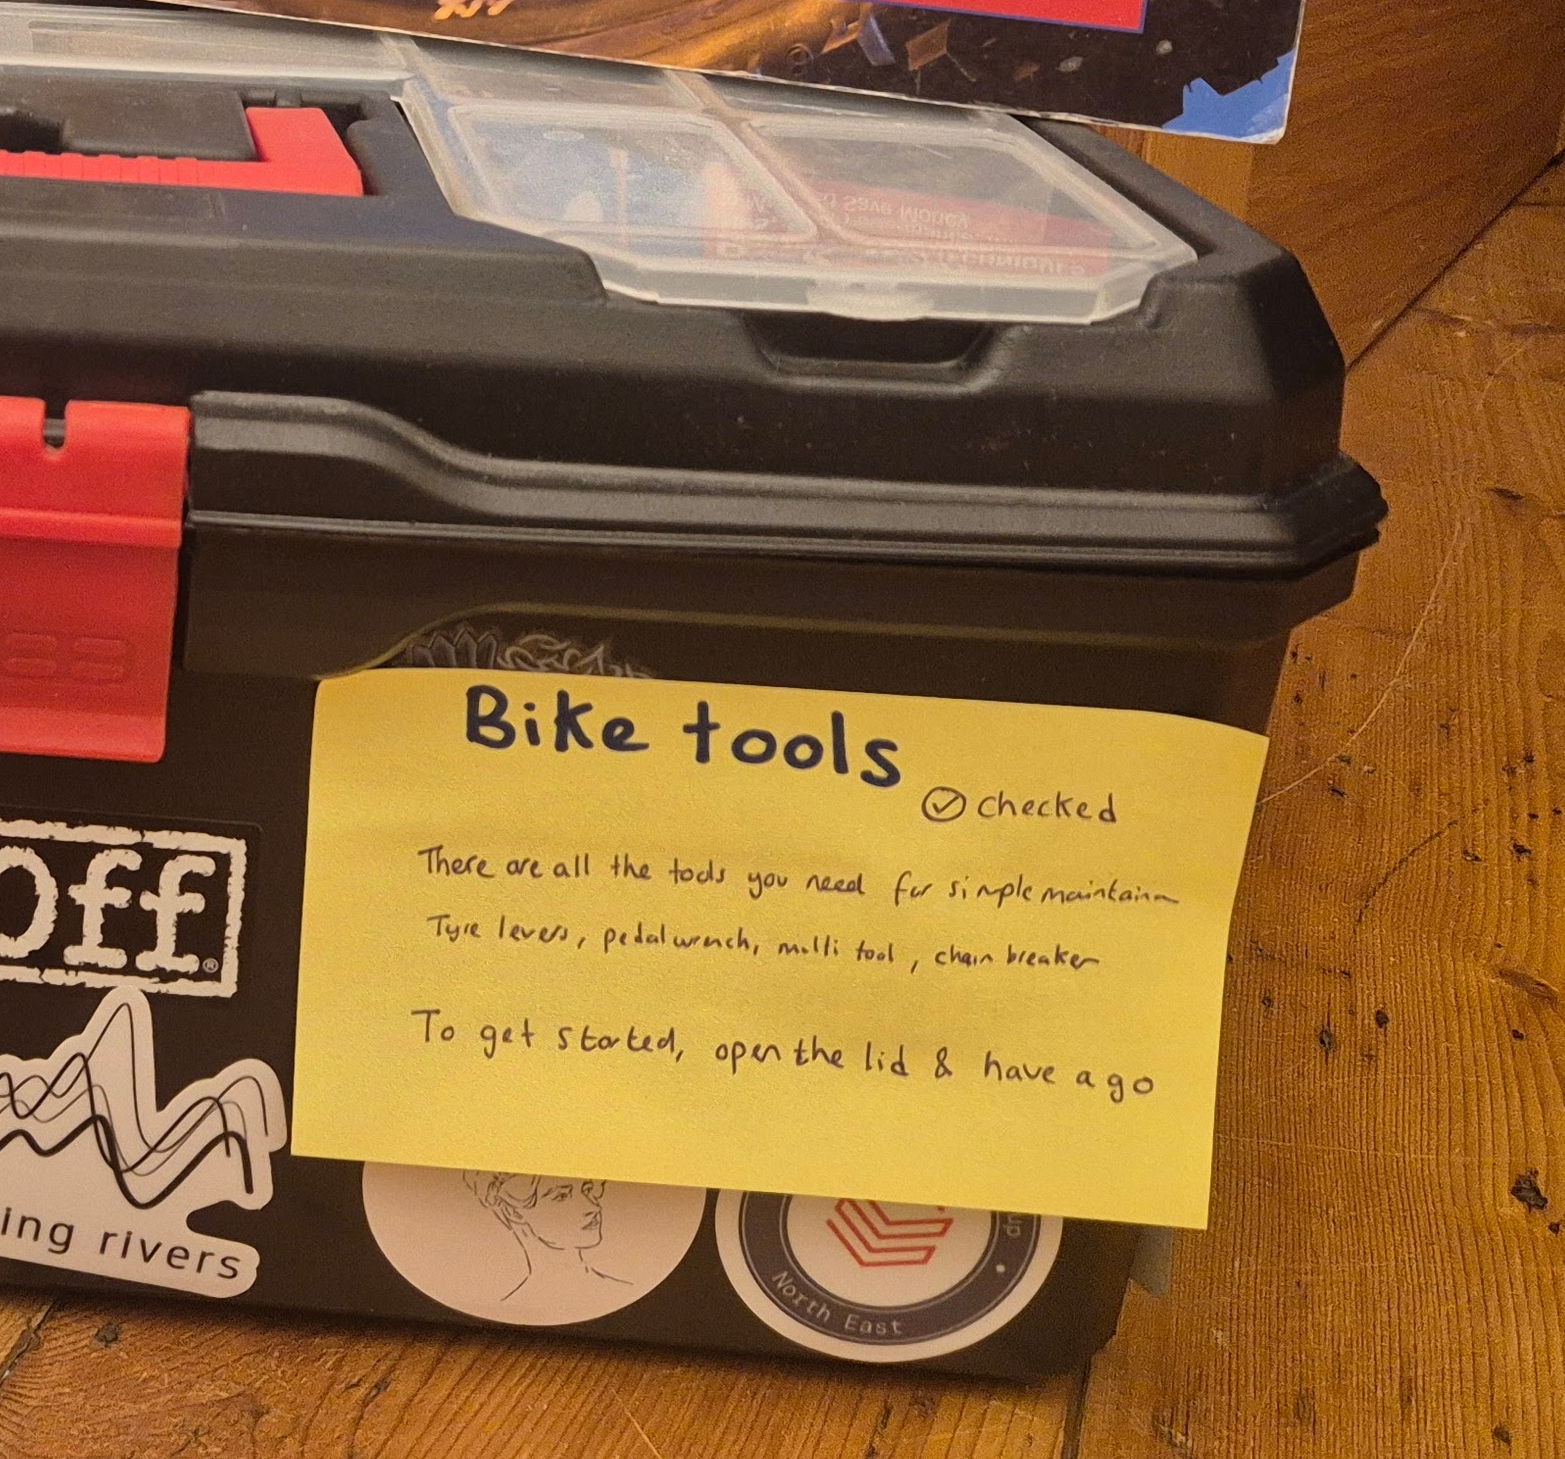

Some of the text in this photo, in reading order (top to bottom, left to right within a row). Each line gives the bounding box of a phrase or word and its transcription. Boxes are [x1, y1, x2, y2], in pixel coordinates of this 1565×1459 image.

[465, 684, 902, 788] Bike tools
[418, 844, 497, 881] There
[506, 857, 543, 879] are
[552, 852, 591, 879] all
[609, 853, 652, 882] the
[746, 870, 789, 900] you
[805, 873, 866, 897] need
[892, 870, 934, 908] for
[948, 873, 1033, 909] simple
[426, 913, 482, 941] Tyre
[603, 922, 667, 954] pedal
[934, 942, 994, 969] chain
[1005, 944, 1101, 970] breaker
[410, 1007, 1155, 1104] To get started, open the lid & have a go
[99, 1228, 243, 1280] rivers
[770, 1269, 905, 1337] North East
